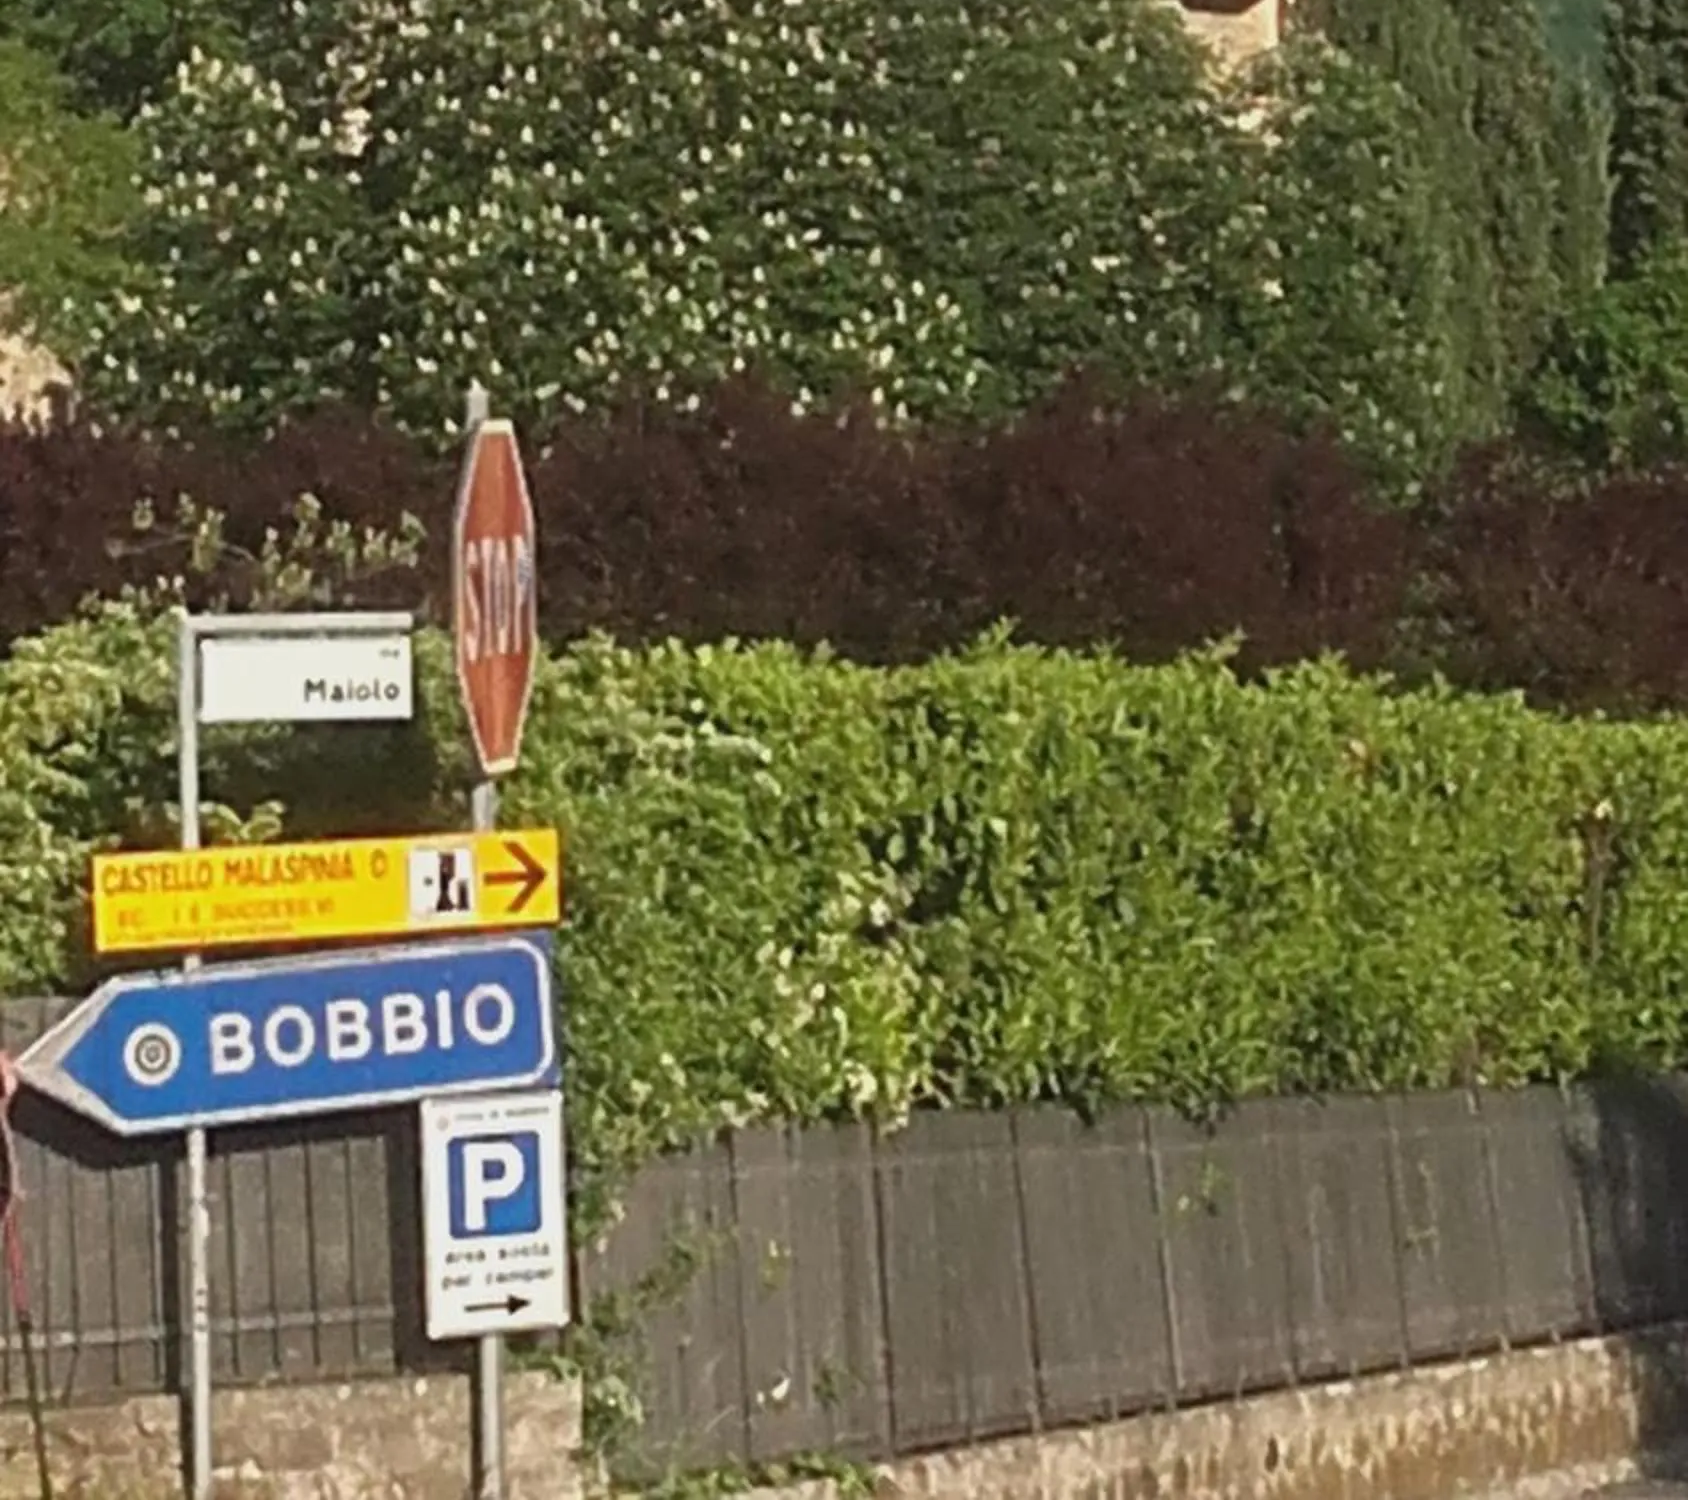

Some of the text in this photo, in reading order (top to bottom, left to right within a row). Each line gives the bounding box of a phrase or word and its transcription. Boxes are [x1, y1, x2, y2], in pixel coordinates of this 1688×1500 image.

[464, 534, 534, 664] STOP
[304, 677, 401, 703] Maiolo
[102, 860, 214, 896] CASTELLO
[223, 849, 354, 887] MALASPINA
[209, 983, 515, 1075] BOBBIO
[463, 1139, 526, 1231] P
